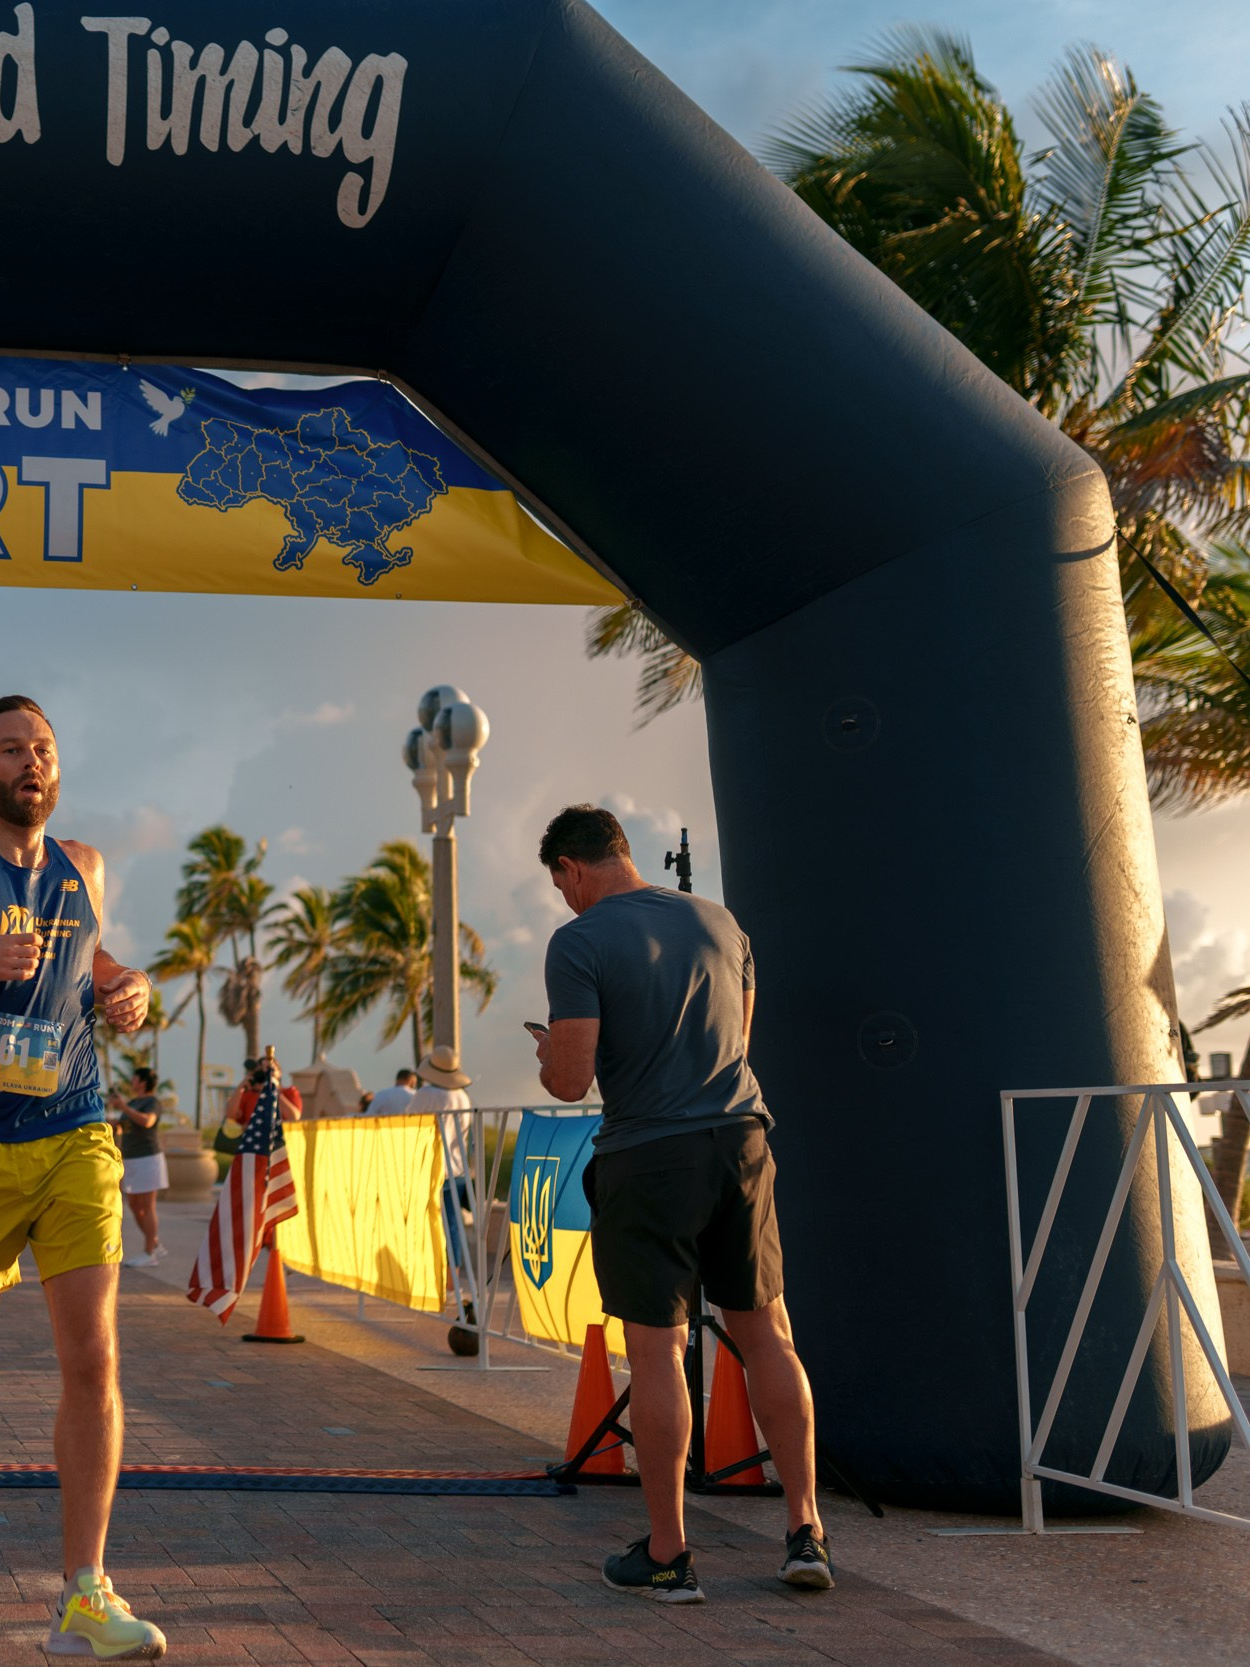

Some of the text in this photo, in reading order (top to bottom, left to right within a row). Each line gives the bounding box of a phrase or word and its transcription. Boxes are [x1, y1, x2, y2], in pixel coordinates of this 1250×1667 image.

[81, 16, 409, 229] Timing
[33, 1023, 55, 1032] RUN
[652, 1570, 677, 1584] HOKA
